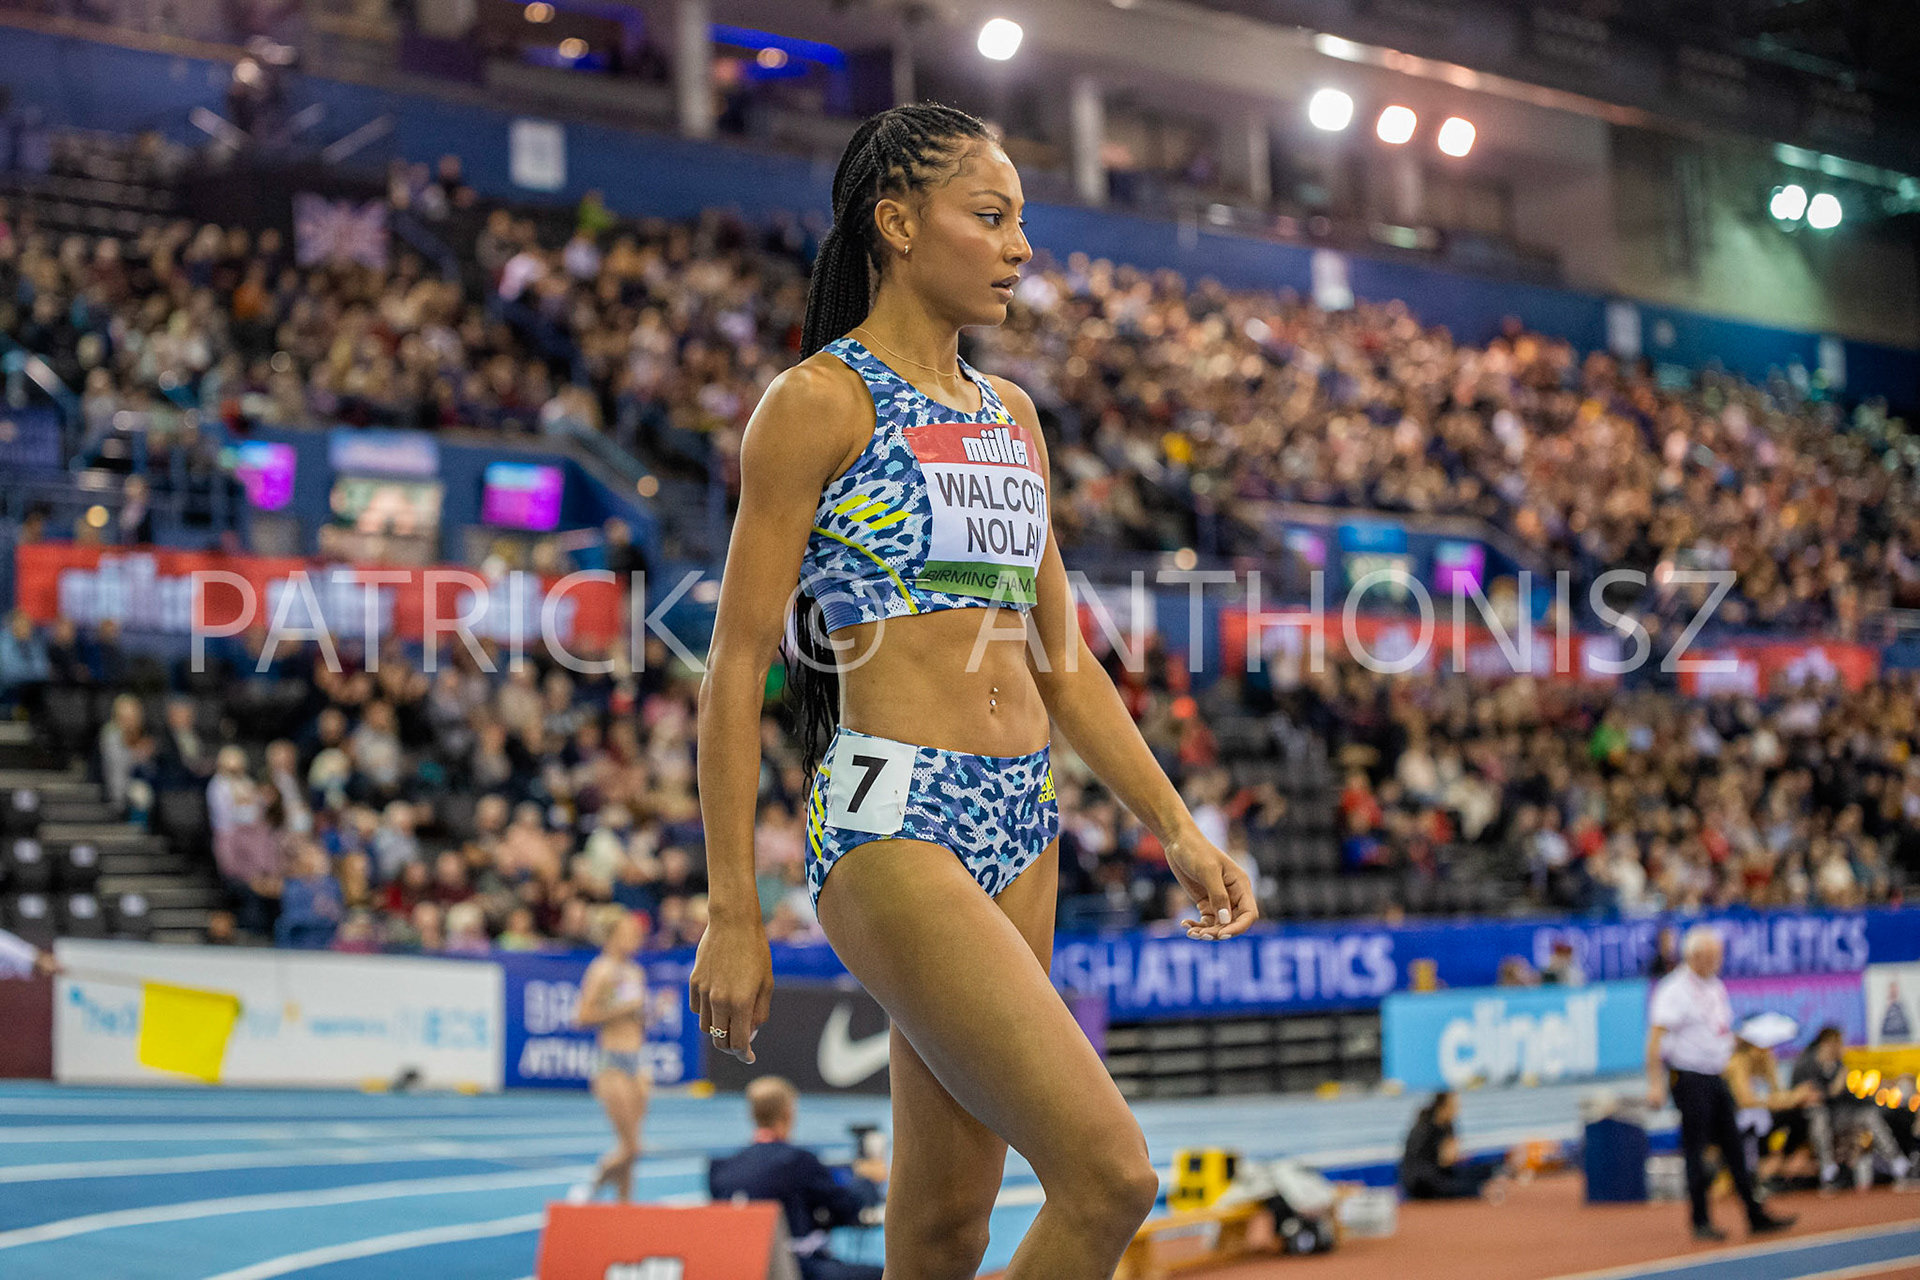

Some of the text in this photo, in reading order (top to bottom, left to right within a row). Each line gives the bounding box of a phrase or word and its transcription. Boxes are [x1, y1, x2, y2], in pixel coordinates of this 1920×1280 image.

[935, 472, 1045, 522] WALCOTT
[924, 569, 1031, 592] BIRMINGHAM
[847, 754, 888, 813] 7
[1718, 914, 1870, 977] THLETICS
